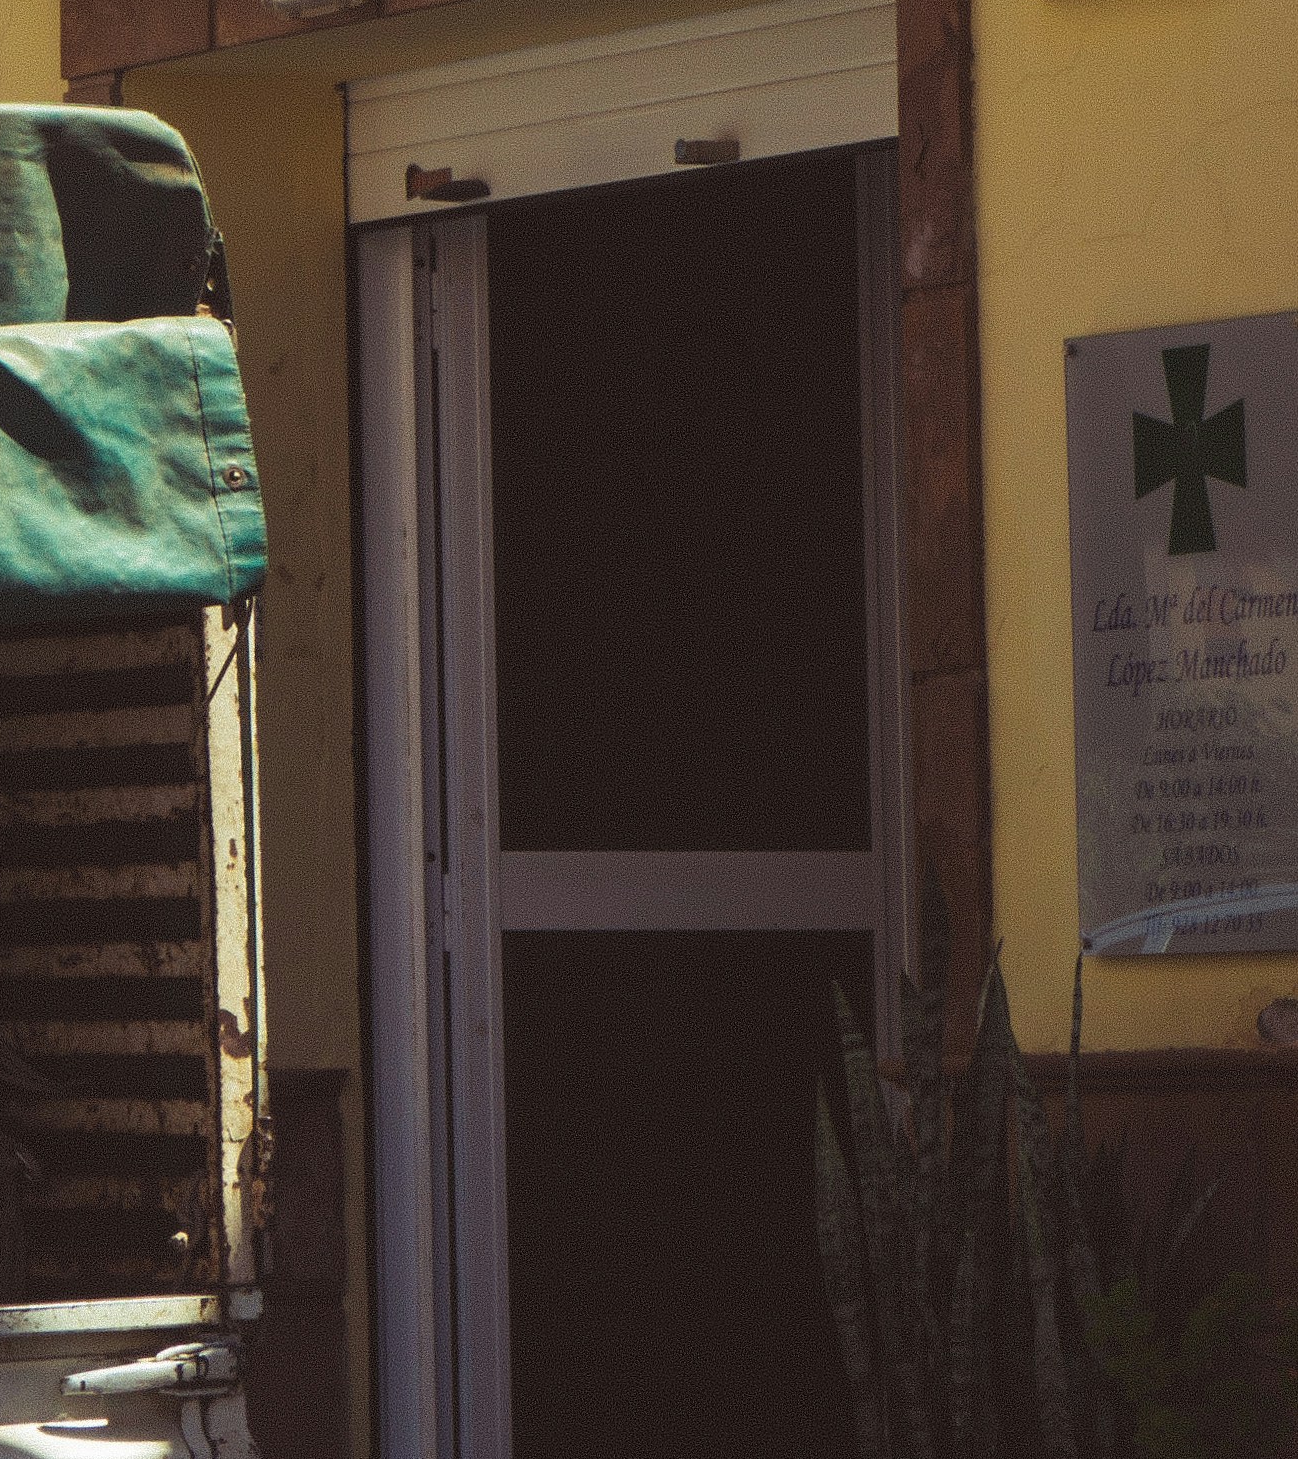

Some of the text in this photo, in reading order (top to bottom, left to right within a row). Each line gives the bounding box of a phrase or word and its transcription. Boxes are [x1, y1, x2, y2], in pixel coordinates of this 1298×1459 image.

[1093, 592, 1137, 633] Lda.
[1183, 584, 1215, 627] del
[1218, 587, 1298, 628] Carmen
[1107, 638, 1287, 697] López Manchado
